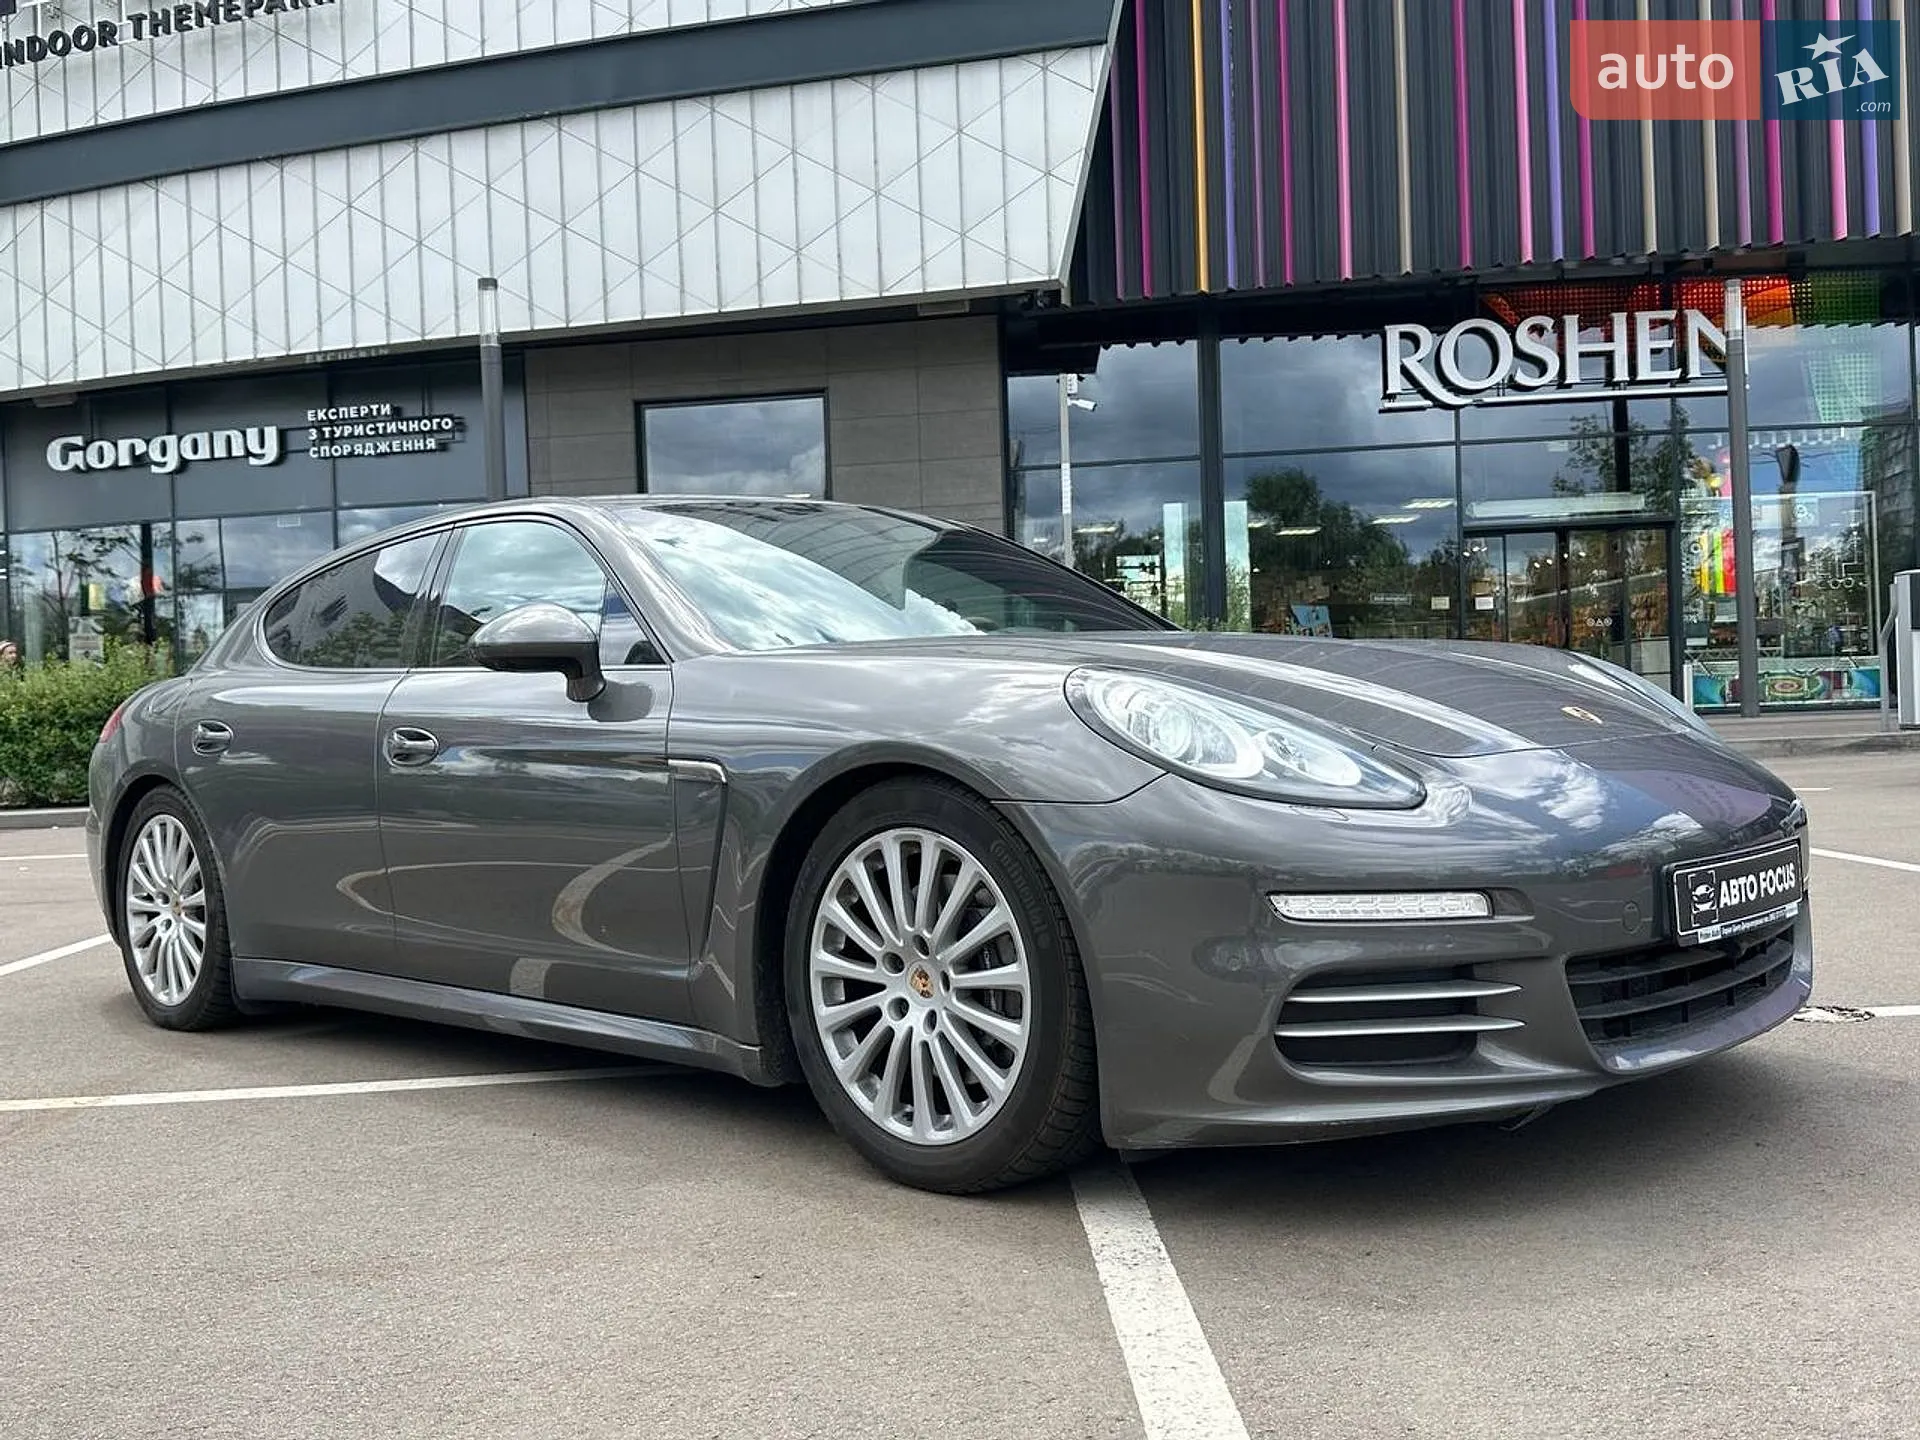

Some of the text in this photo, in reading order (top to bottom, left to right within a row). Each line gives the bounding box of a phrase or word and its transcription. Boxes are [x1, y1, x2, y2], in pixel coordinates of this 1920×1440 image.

[0, 0, 334, 69] NDOOR THEMEPA
[1383, 308, 1750, 406] ROSHEN
[307, 403, 392, 422] ЕКСПЕРТИ
[322, 417, 453, 439] ТУРИСТИЧНОГО
[46, 424, 279, 474] Gorgany
[309, 437, 437, 459] СПОРЯДЖЕННЯ
[1759, 862, 1796, 898] FOCUS
